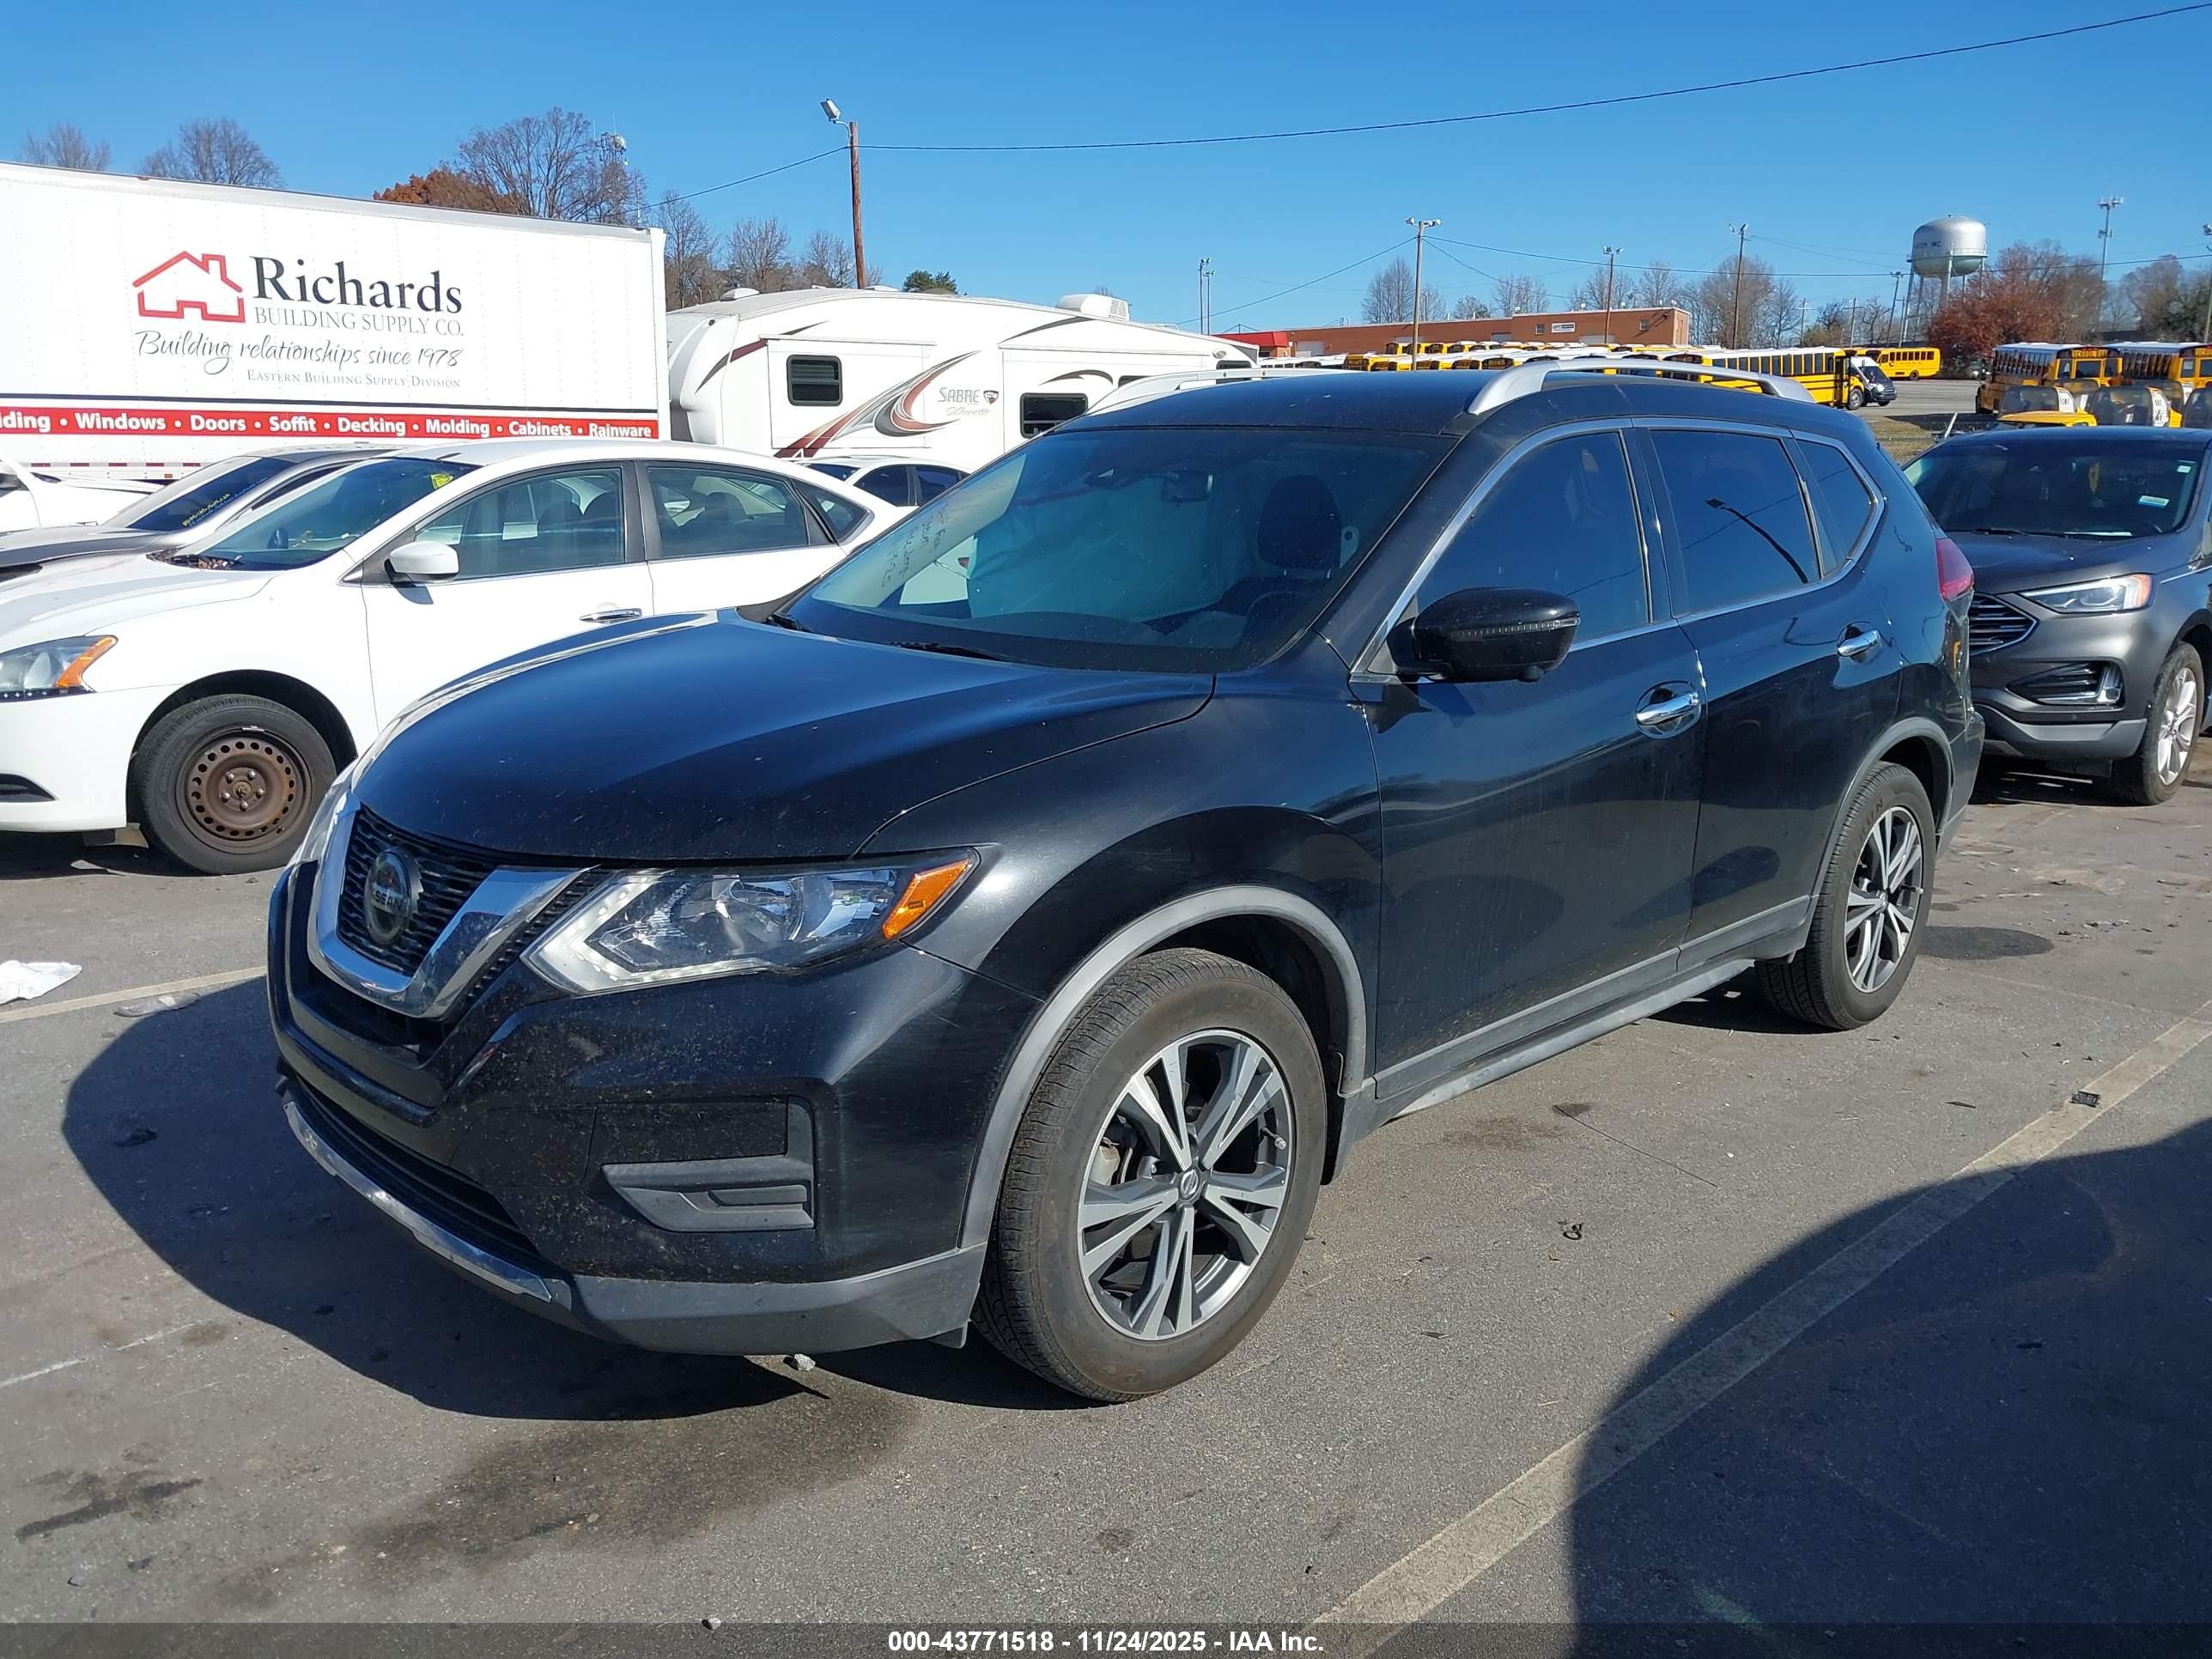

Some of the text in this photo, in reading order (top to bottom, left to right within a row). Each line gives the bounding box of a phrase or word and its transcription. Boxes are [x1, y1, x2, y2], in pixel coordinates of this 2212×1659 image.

[250, 256, 462, 314] Richards
[254, 307, 464, 337] BUILDING SUPPLY CO.
[134, 330, 465, 375] Building relationships since 1978
[937, 386, 981, 403] SABRE
[0, 410, 652, 439] ding Windows Doors Soffit Decking Molding Cabinets Rainware
[373, 890, 403, 911] SSAN
